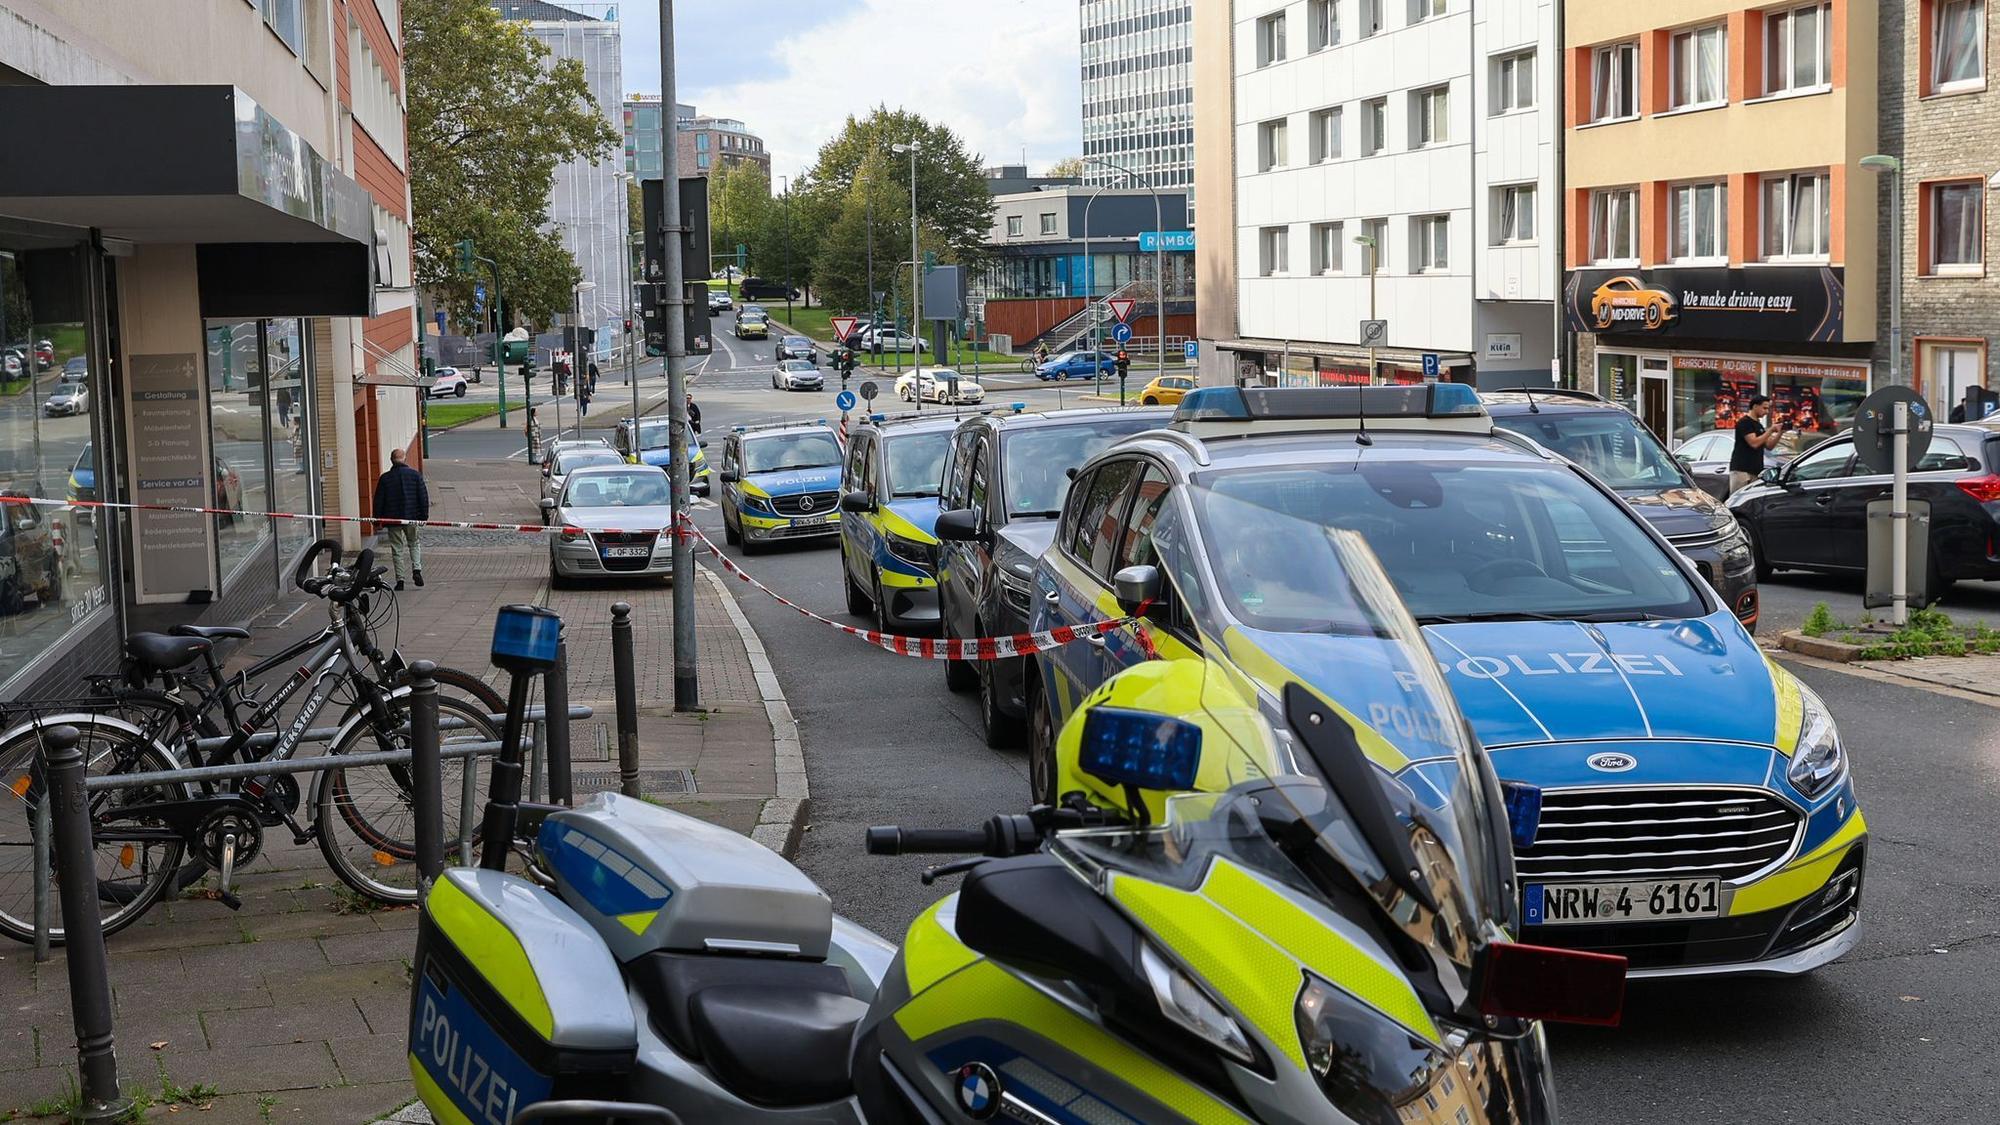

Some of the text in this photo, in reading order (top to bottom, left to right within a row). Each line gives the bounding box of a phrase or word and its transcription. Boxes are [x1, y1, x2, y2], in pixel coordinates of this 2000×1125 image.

[1683, 290, 1793, 313] We make driving easy
[1612, 308, 1646, 321] MD-DRIVE
[1678, 358, 1757, 372] FAHRSCHULE MD-DRIVE
[144, 391, 187, 401] Gestaltung
[142, 479, 200, 490] Service vor Ort
[776, 475, 827, 487] POLIZEI
[629, 546, 648, 556] 3325
[1600, 757, 1624, 767] Ford
[1543, 887, 1600, 919] NRW
[1529, 908, 1538, 917] D
[420, 994, 519, 1125] POLIZEI
